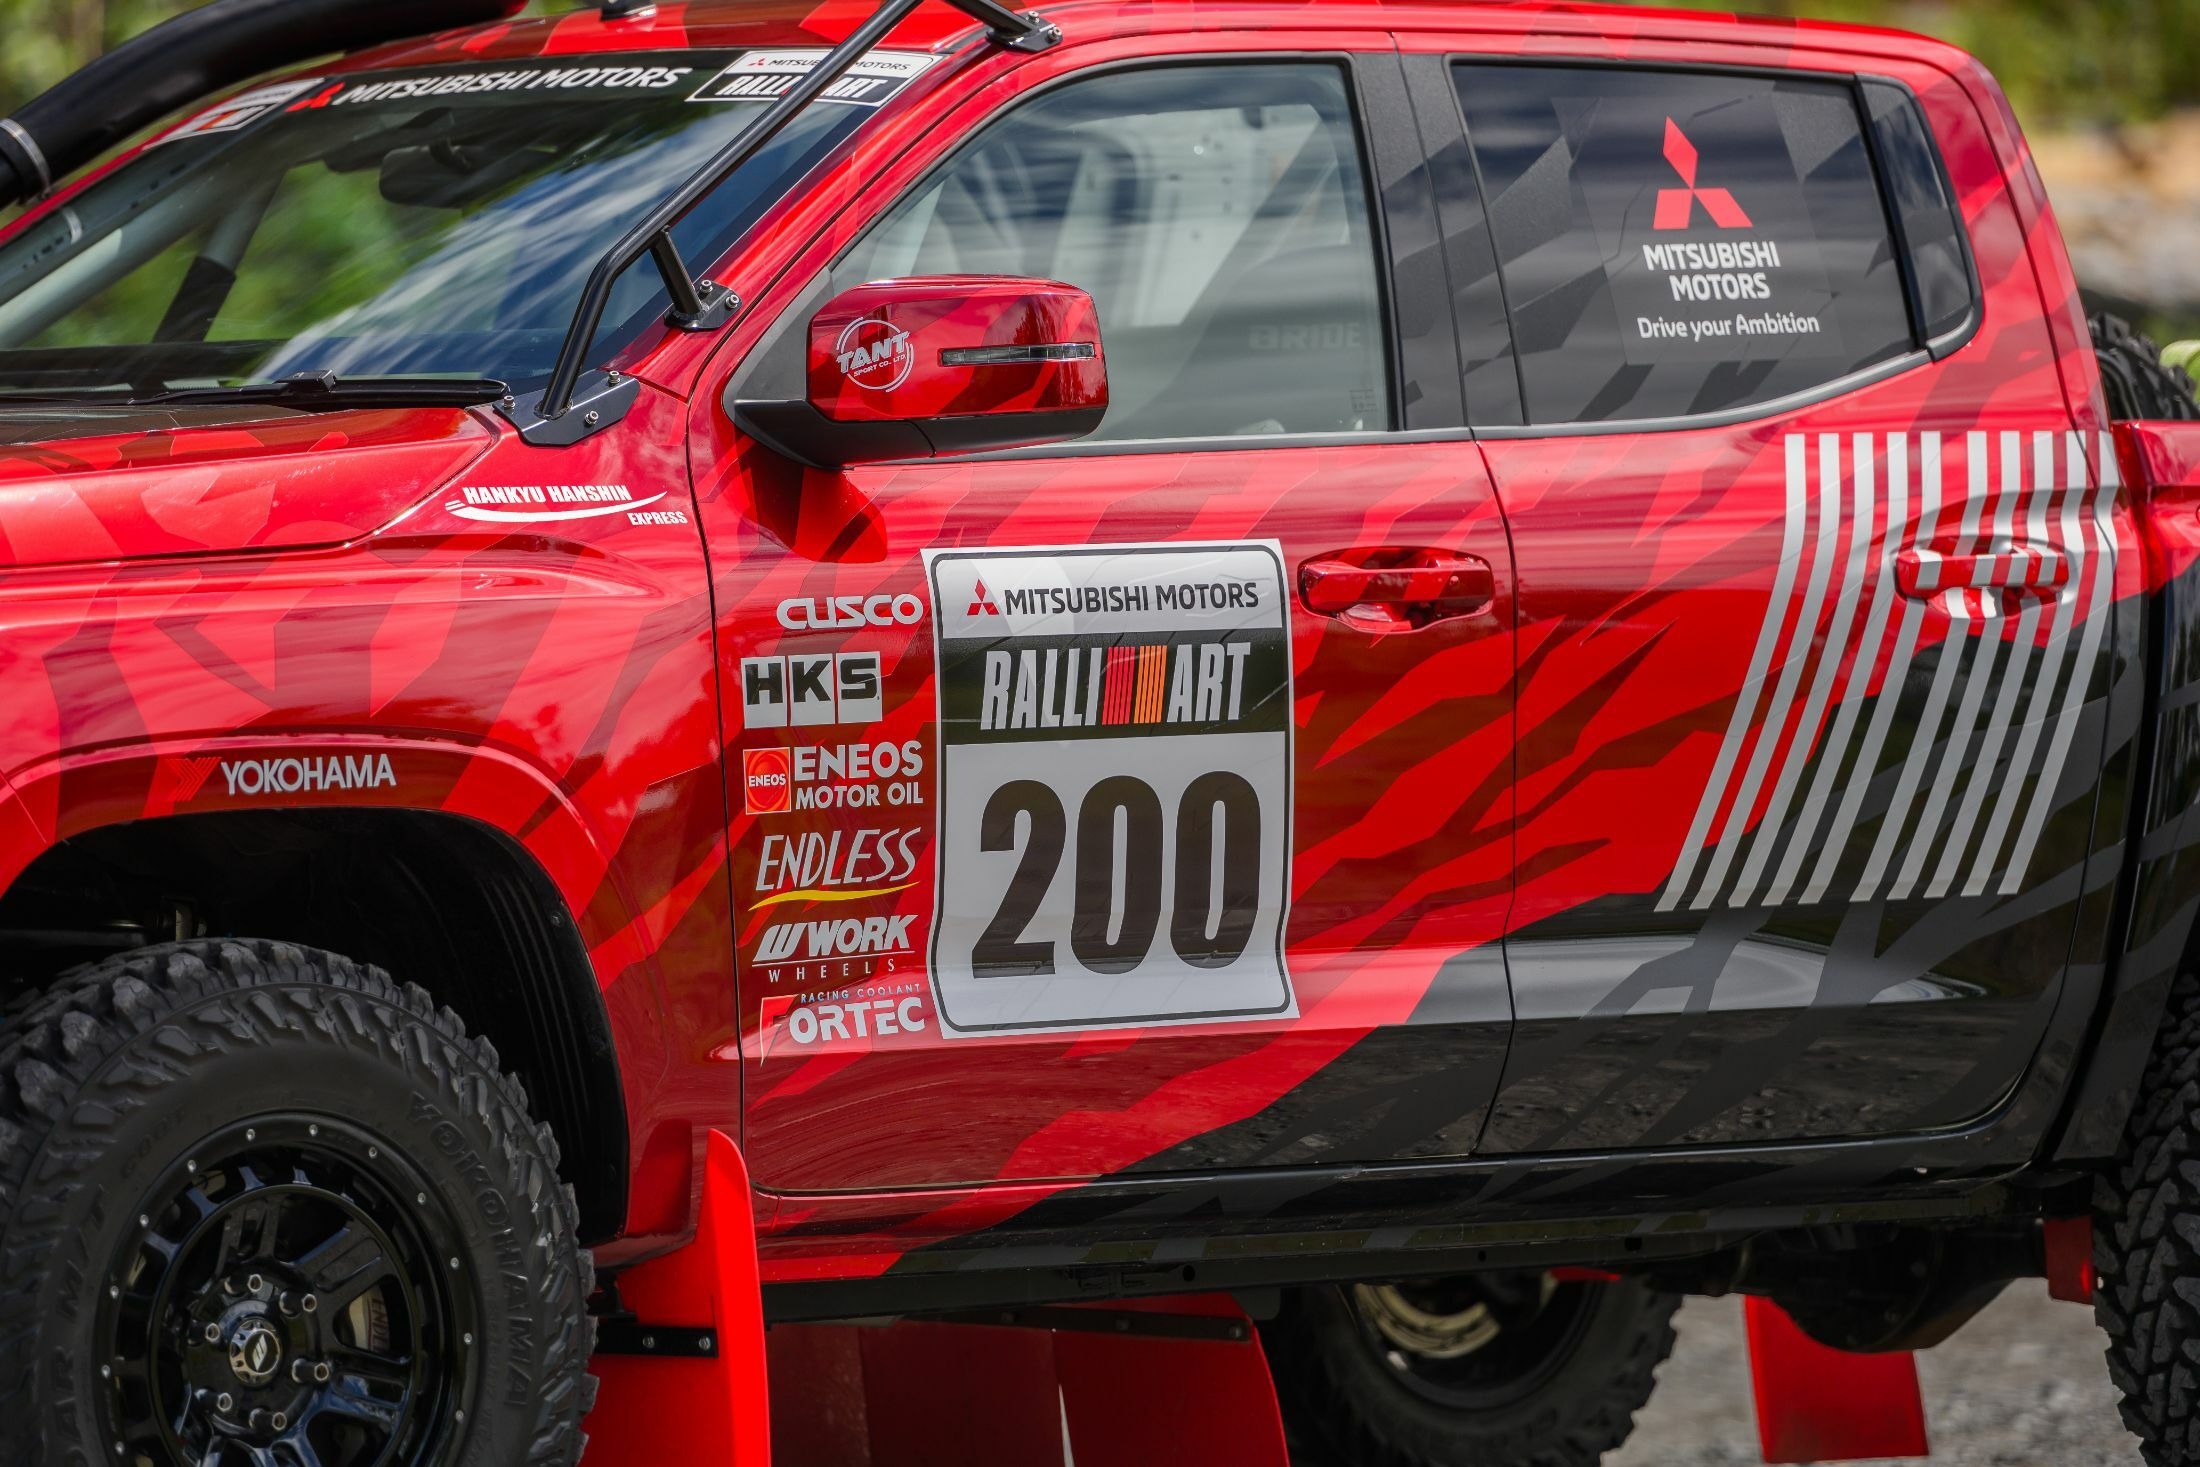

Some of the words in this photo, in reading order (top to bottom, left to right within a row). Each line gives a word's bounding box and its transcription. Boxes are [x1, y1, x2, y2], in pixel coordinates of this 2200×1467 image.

[332, 69, 541, 106] MITSUBISHI
[525, 67, 693, 89] MOTORS
[1643, 240, 1781, 271] MITSUBISHI
[1669, 272, 1771, 301] MOTORS
[1637, 316, 1688, 339] Drive
[1690, 317, 1732, 342] your
[1735, 312, 1820, 336] Ambition
[836, 331, 910, 374] TANT
[854, 363, 878, 378] SPORT
[462, 485, 547, 505] HANKYU
[546, 484, 633, 502] HANSHIN
[626, 511, 688, 526] EXPRESS
[776, 593, 924, 631] CUSCO
[1004, 583, 1152, 616] MITSUBISHI
[1156, 582, 1260, 611] MOTORS
[744, 656, 880, 707] HKS
[220, 753, 397, 796] YOKOHAMA
[793, 740, 924, 782] ENEOS
[748, 773, 787, 788] ENEOS
[795, 784, 881, 811] MOTOR
[887, 782, 924, 805] OIL
[755, 826, 922, 891] ENDLESS
[971, 770, 1262, 979] 200
[768, 958, 896, 983] WHEELS
[801, 990, 850, 1004] RACING
[857, 983, 921, 998] COOLANT
[407, 1090, 534, 1407] YOKOHAMA
